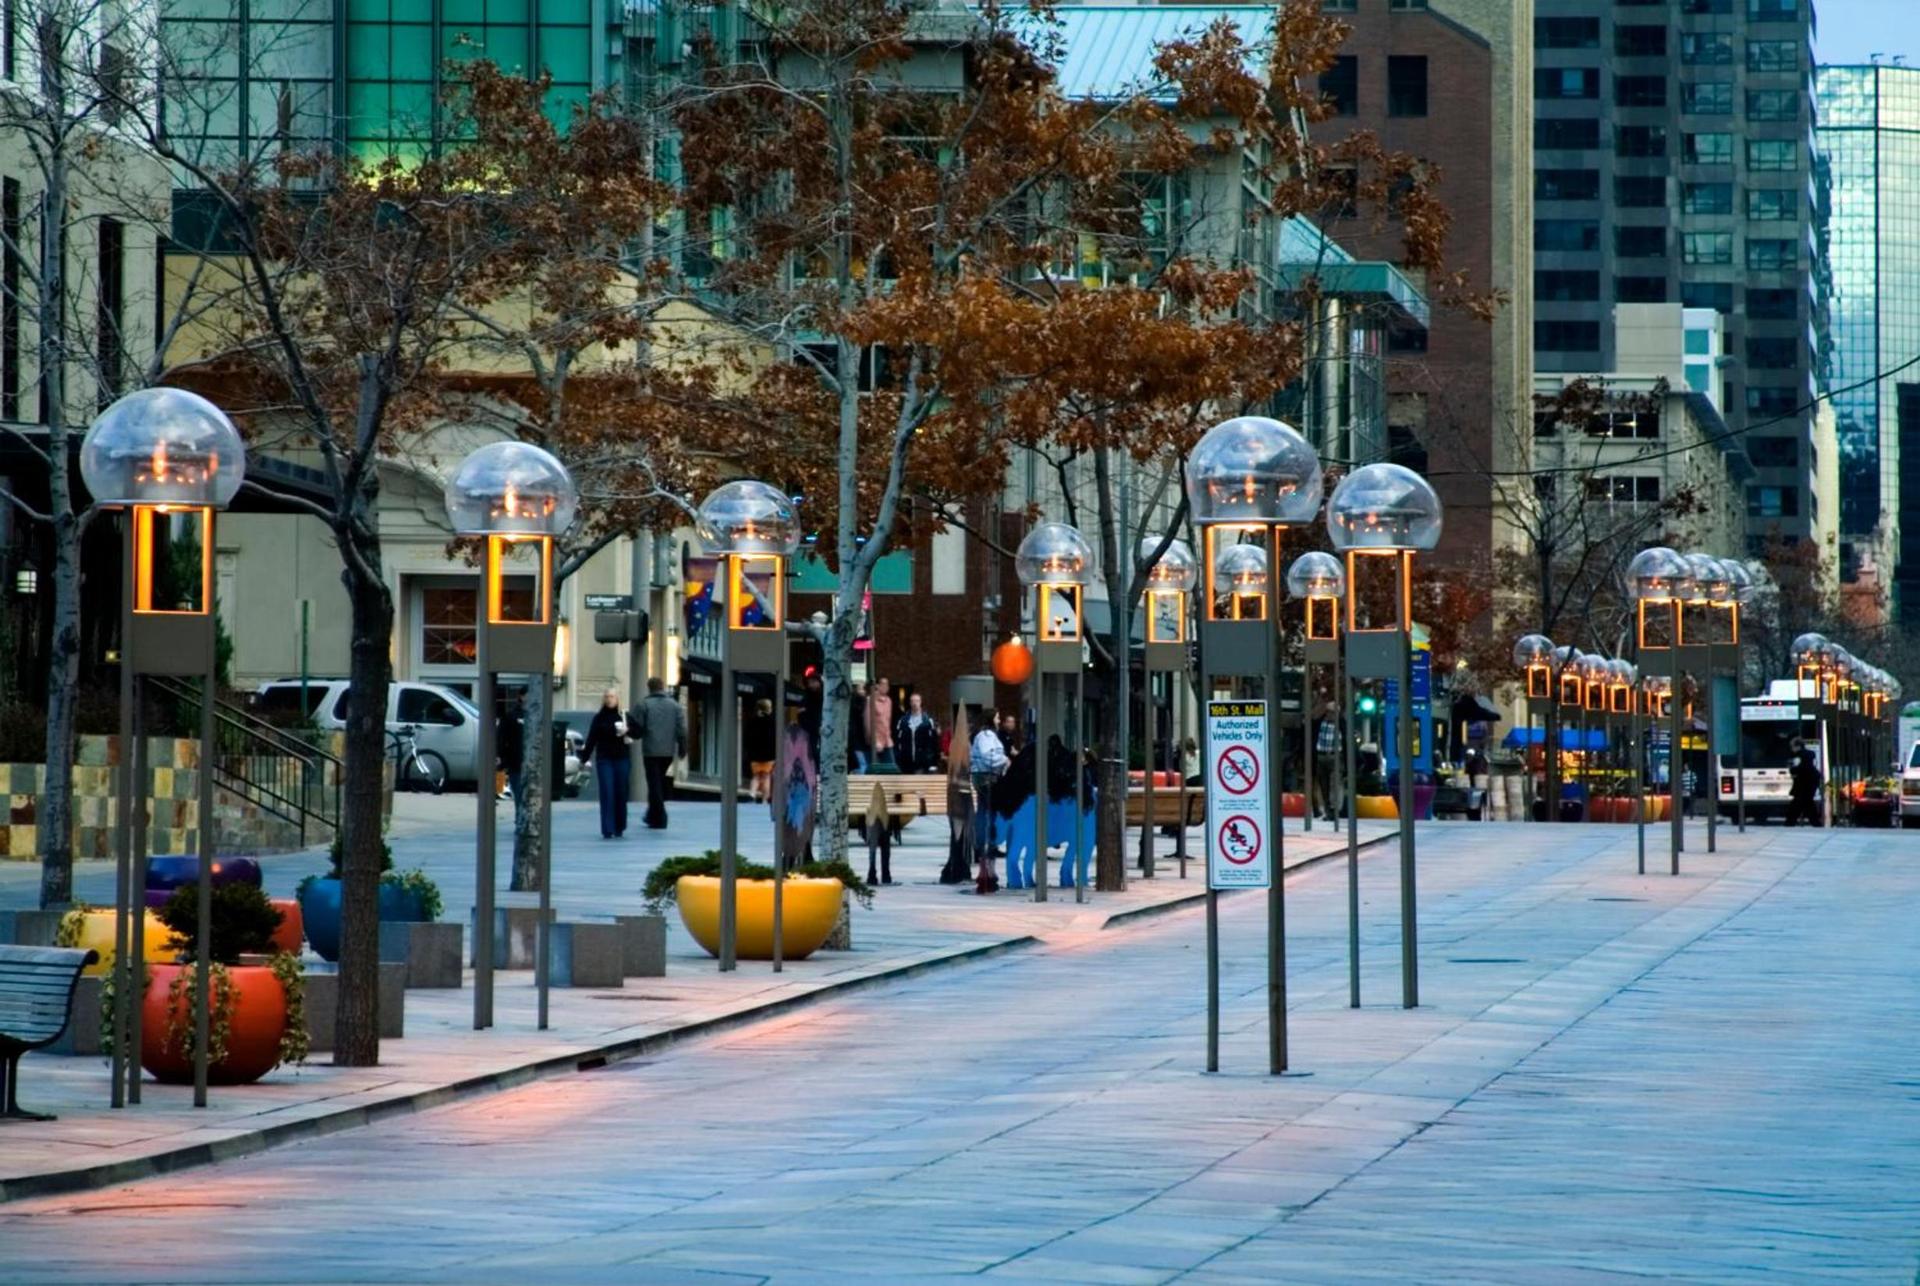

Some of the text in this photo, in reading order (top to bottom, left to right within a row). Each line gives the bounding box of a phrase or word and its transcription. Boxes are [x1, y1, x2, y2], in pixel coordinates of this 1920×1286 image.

[1245, 704, 1264, 715] Mall
[1216, 720, 1259, 729] Authorized
[1212, 731, 1263, 742] Vehicles Only
